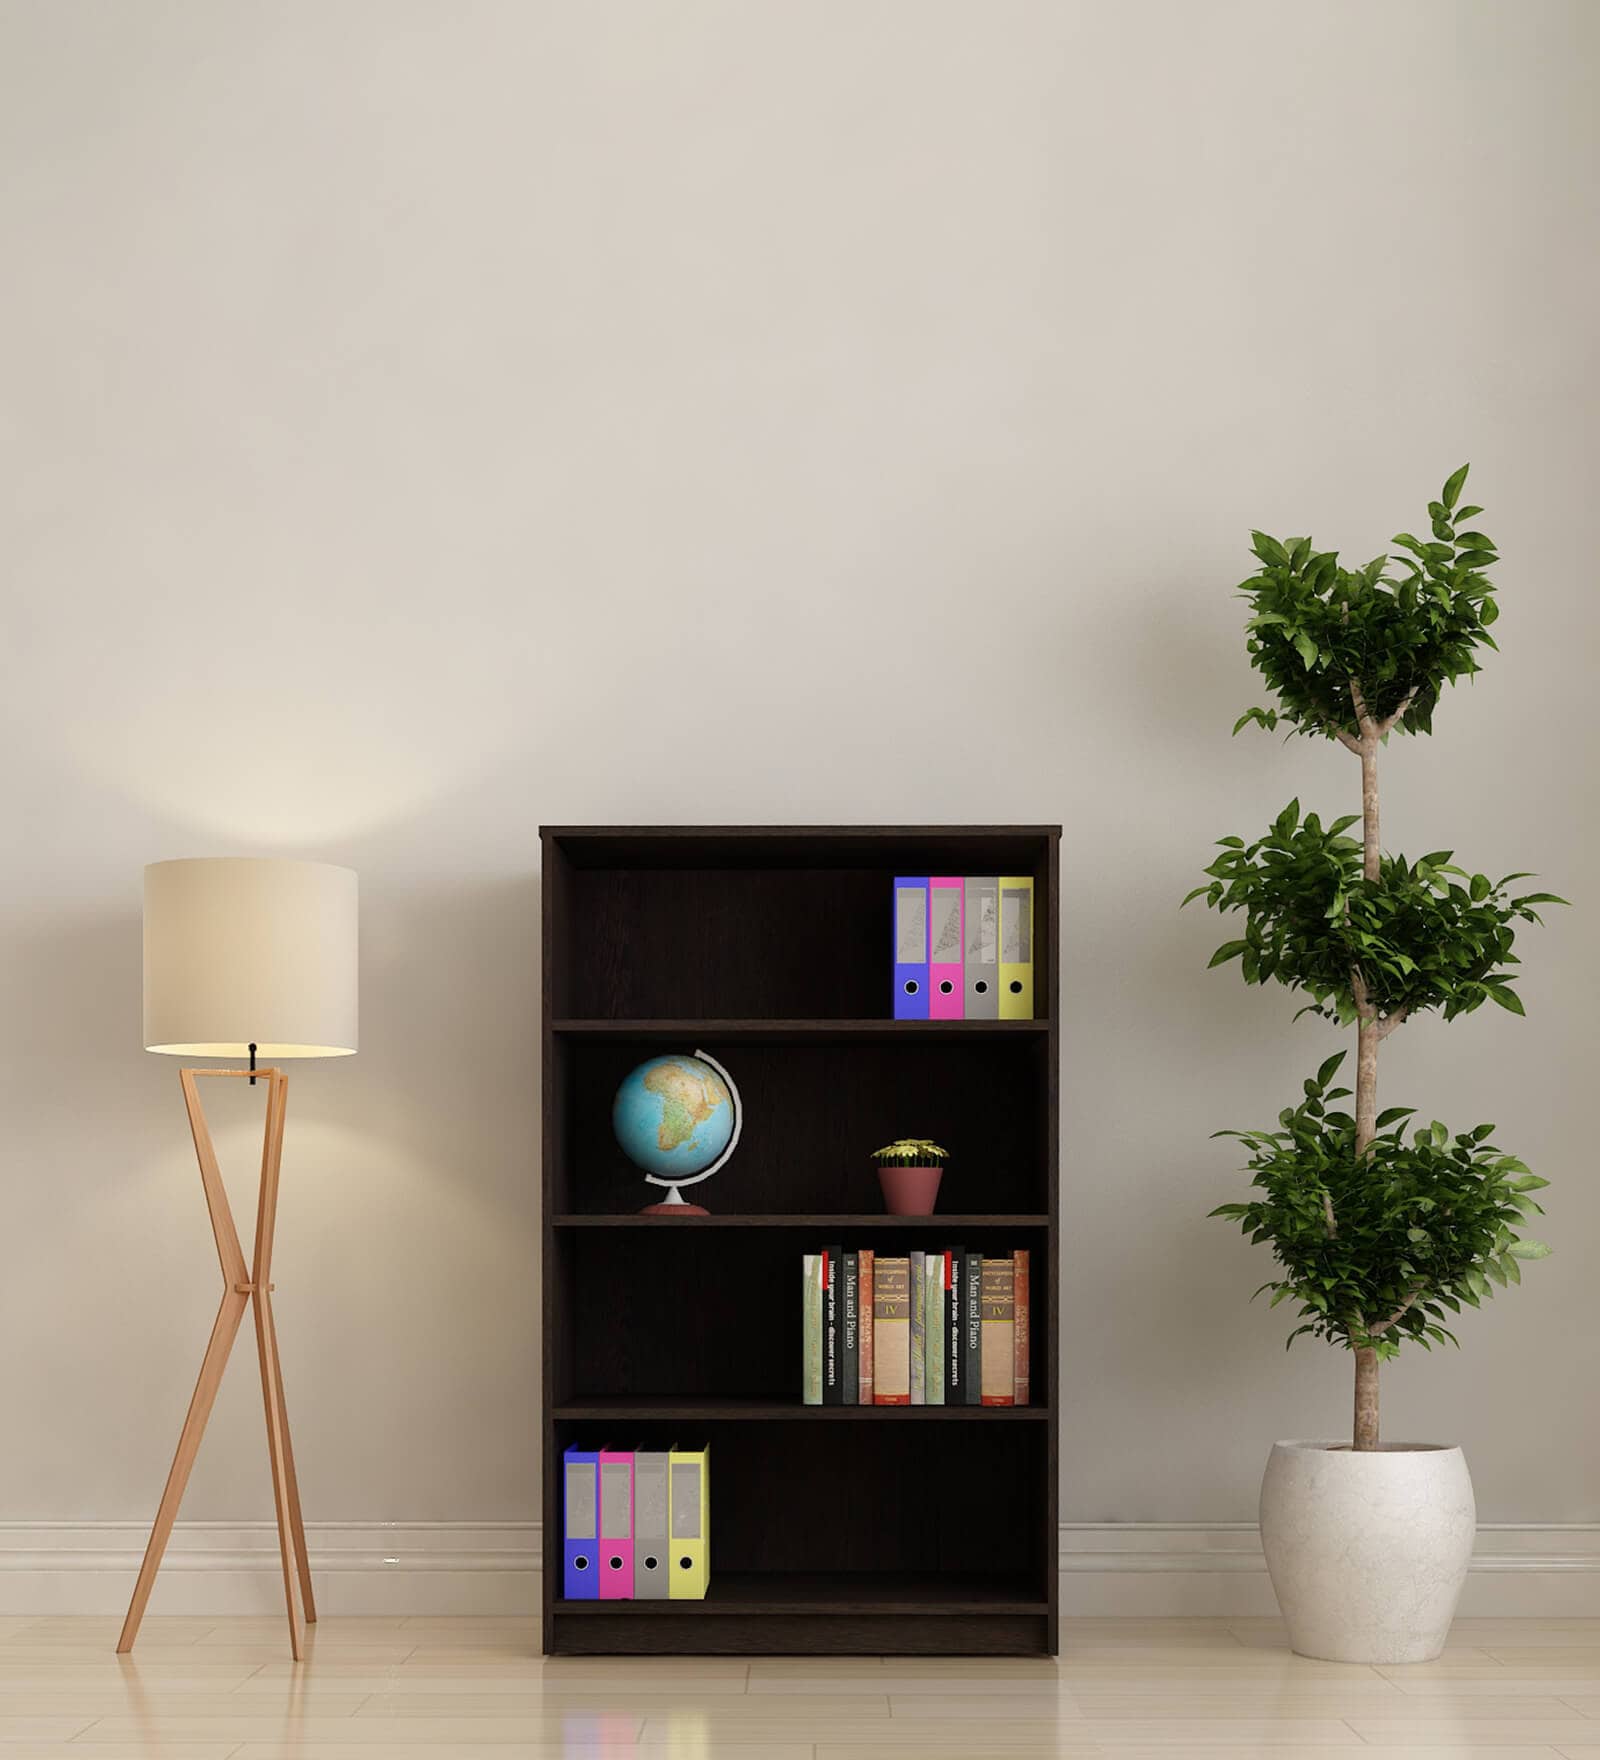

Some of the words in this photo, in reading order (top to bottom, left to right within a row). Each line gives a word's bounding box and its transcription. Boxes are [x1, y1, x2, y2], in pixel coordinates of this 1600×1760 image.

[828, 1261, 836, 1283] Inside
[951, 1261, 959, 1283] Inside
[827, 1284, 835, 1301] your
[847, 1275, 856, 1297] Man
[950, 1284, 958, 1301] your
[970, 1275, 980, 1297] Man
[828, 1302, 836, 1321] brain
[847, 1299, 856, 1318] and
[884, 1304, 898, 1315] IV
[951, 1302, 959, 1321] brain
[970, 1299, 980, 1318] and
[992, 1306, 1005, 1316] IV
[828, 1327, 836, 1358] discover
[847, 1321, 856, 1349] Piano
[951, 1327, 959, 1358] discover
[970, 1321, 980, 1349] Piano
[828, 1359, 836, 1386] secrets
[951, 1359, 959, 1386] secrets
